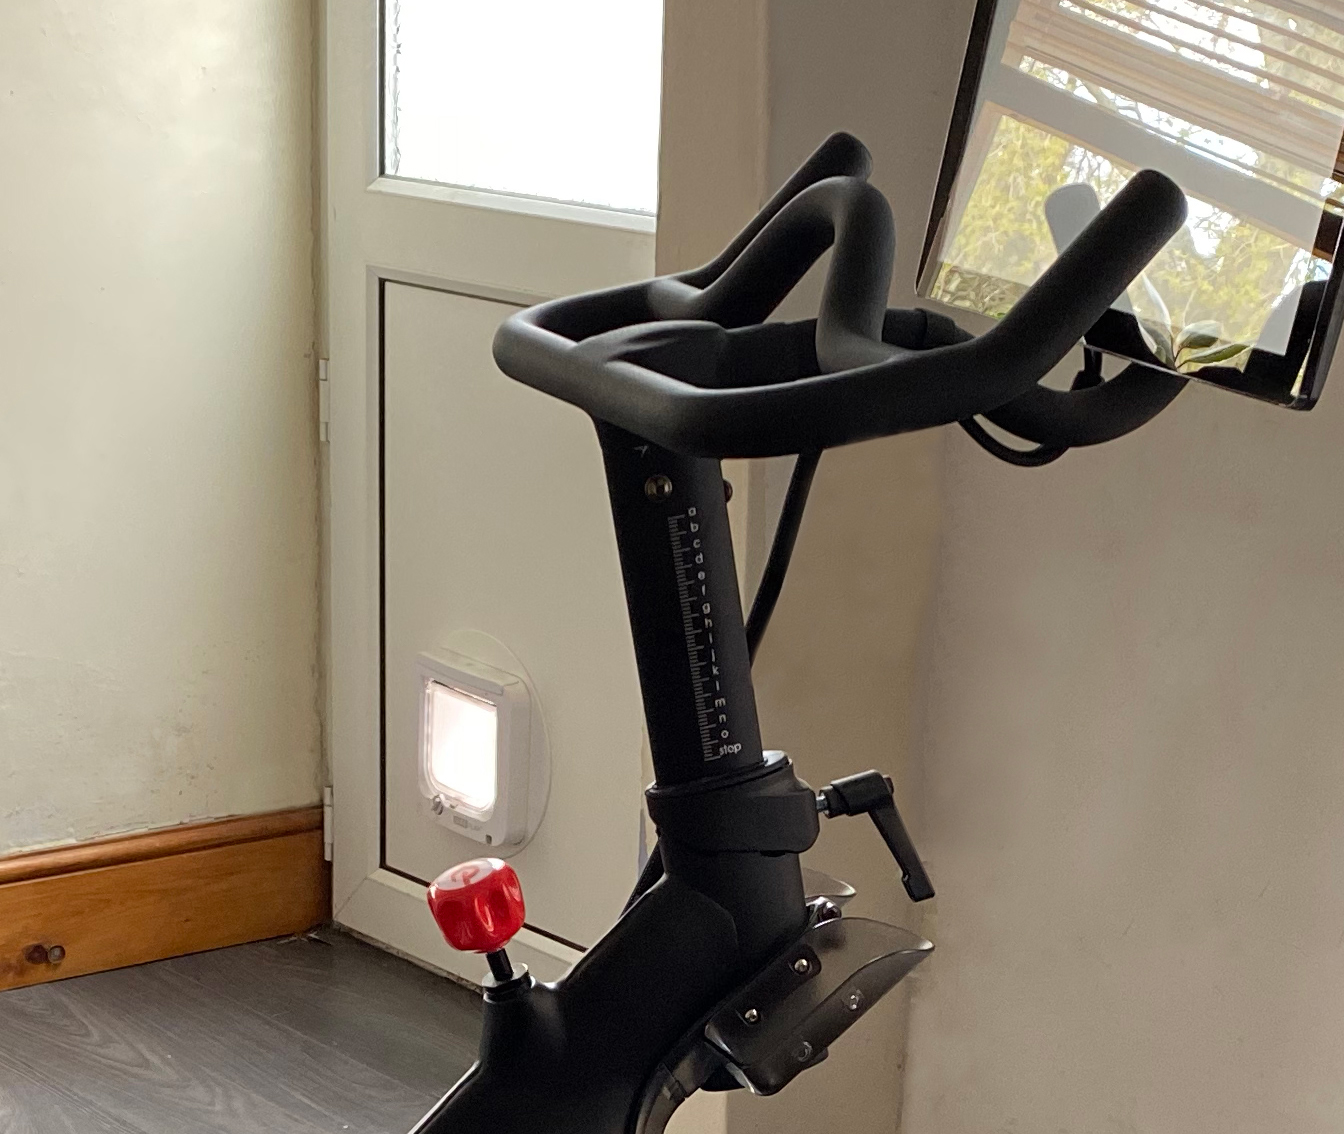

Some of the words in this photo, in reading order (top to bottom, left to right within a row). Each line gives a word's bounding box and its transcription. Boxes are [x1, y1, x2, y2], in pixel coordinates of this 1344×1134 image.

[690, 522, 699, 532] b
[693, 539, 701, 548] c
[695, 552, 704, 564] d
[712, 665, 719, 675] k
[714, 697, 726, 708] m
[718, 714, 727, 723] n
[720, 729, 729, 738] o
[719, 742, 742, 755] stop
